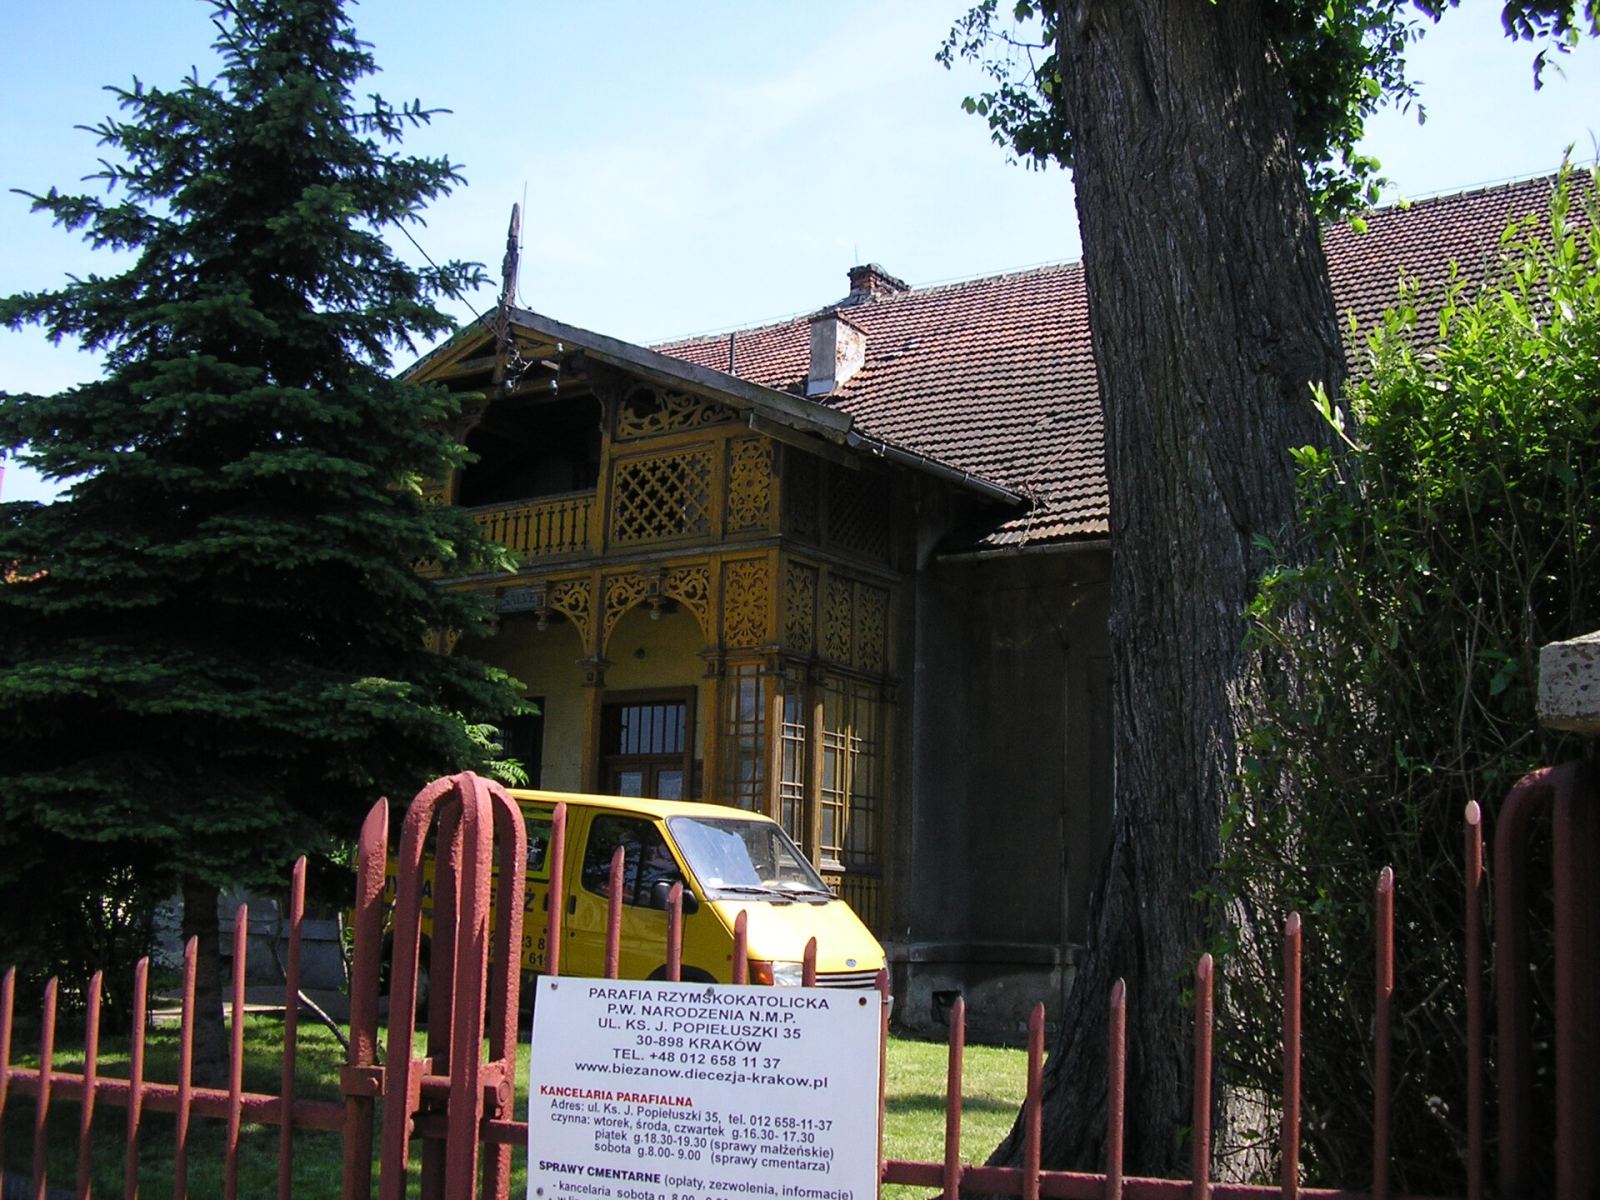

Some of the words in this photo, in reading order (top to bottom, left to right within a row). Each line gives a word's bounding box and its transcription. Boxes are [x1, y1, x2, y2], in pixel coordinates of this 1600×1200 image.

[588, 987, 653, 1001] PARAFIA
[657, 991, 830, 1010] RZYMSKOKATOLICKA
[607, 1003, 636, 1015] P.W.
[641, 1005, 745, 1021] NARODZENIA
[749, 1011, 796, 1024] N.M.P.
[598, 1017, 621, 1030] UL.
[626, 1019, 650, 1031] KS.
[655, 1021, 667, 1032] J.
[673, 1022, 778, 1038] POPIEŁUSZKI
[783, 1028, 801, 1039] 35
[636, 1035, 684, 1048] 30-898
[689, 1038, 762, 1052] KRAKÓW
[613, 1048, 644, 1060] TEL.
[649, 1051, 675, 1063] +48
[680, 1052, 706, 1065] 012
[710, 1054, 736, 1067] 658
[742, 1057, 757, 1068] 11
[763, 1057, 781, 1069] 37
[575, 1062, 828, 1090] www.biezanow.diecezja-krakow.pl
[540, 1085, 613, 1101] KANCELARIA
[616, 1091, 693, 1107] PARAFIALNA
[550, 1098, 585, 1112] Adres:
[588, 1101, 600, 1113] ul.
[603, 1103, 620, 1115] Ks.
[624, 1104, 633, 1116] J.
[637, 1106, 702, 1122] Popiełuszki
[705, 1111, 721, 1125] 35,
[729, 1114, 746, 1126] tel.
[749, 1114, 771, 1128] 012
[774, 1117, 833, 1131] 658-11-37
[551, 1112, 590, 1126] czynna:
[594, 1117, 633, 1131] wtorek,
[636, 1119, 671, 1133] środa,
[674, 1123, 725, 1137] czwartek
[782, 1131, 815, 1144] 17.30
[595, 1129, 627, 1142] piątek
[634, 1133, 707, 1149] g.18.30-19.30
[710, 1138, 757, 1155] (sprawy
[760, 1143, 834, 1161] małżeńskie)
[594, 1141, 631, 1155] sobota
[678, 1149, 701, 1162] 9.00
[711, 1151, 758, 1168] (sprawy
[761, 1157, 831, 1174] cmentarza)
[539, 1160, 584, 1176] SPRAWY
[587, 1166, 661, 1184] CMENTARNE
[664, 1173, 706, 1191] (opłaty,
[709, 1180, 778, 1197] zezwolenia,
[782, 1186, 854, 1200] informacje)
[559, 1180, 611, 1197] kancelaria
[617, 1189, 655, 1200] sobota
